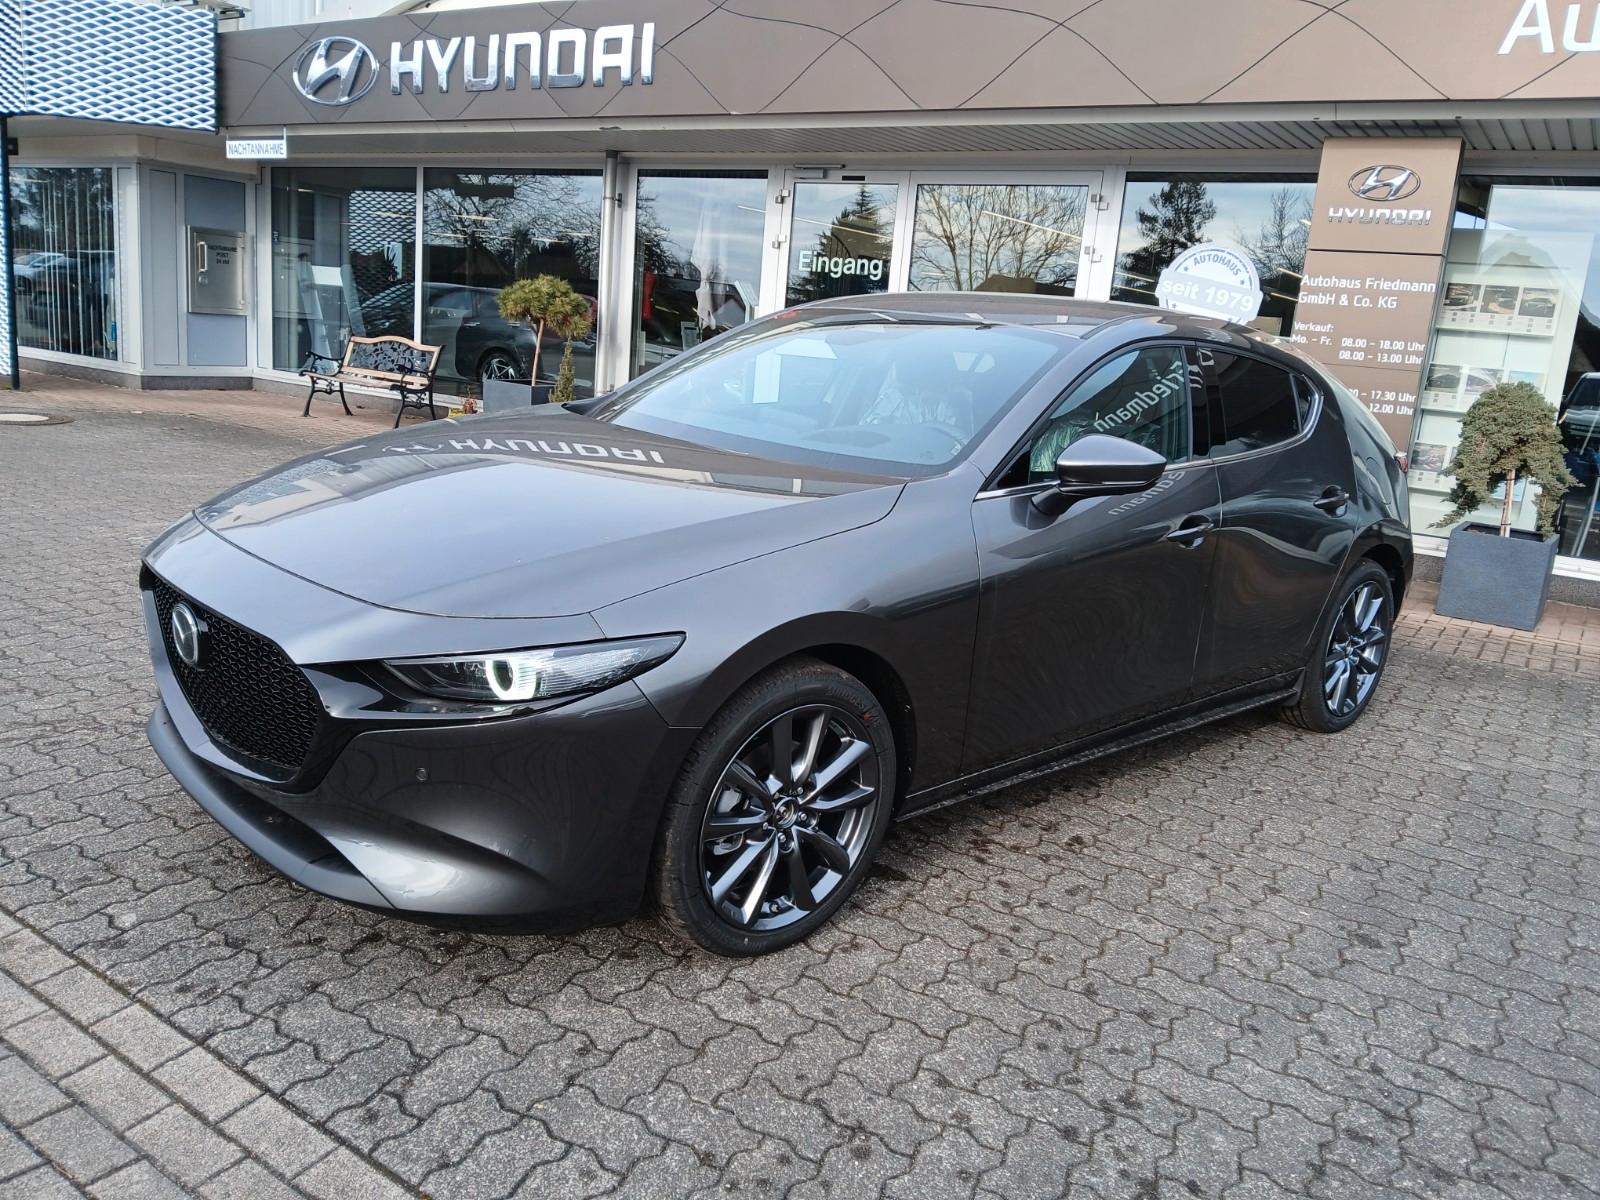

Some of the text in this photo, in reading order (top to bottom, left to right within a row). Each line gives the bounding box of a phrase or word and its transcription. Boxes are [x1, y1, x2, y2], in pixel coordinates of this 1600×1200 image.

[390, 23, 655, 95] HYUNDAI
[228, 143, 285, 155] NACHTANNAHME
[1328, 207, 1432, 226] HYUNDAI
[799, 250, 883, 280] Eingang
[1193, 254, 1241, 276] AUTOHAUS
[1300, 274, 1436, 293] Autohaus Friedmann
[1161, 280, 1254, 312] seit 1979
[1298, 292, 1398, 308] GmbH & Co. KG
[1294, 321, 1334, 332] Verkauf:
[1291, 334, 1309, 344] Mo.
[1320, 336, 1333, 346] Fr.
[1341, 337, 1367, 348] 08.00
[1379, 340, 1405, 351] 18.00
[1407, 341, 1425, 352] Uhr
[1338, 350, 1365, 361] 08.00
[1377, 353, 1402, 364] 13.00
[1405, 354, 1424, 365] Uhr
[1371, 390, 1396, 401] 17.30
[1398, 392, 1416, 403] Uhr
[1369, 403, 1414, 416] 12.00 Uhr
